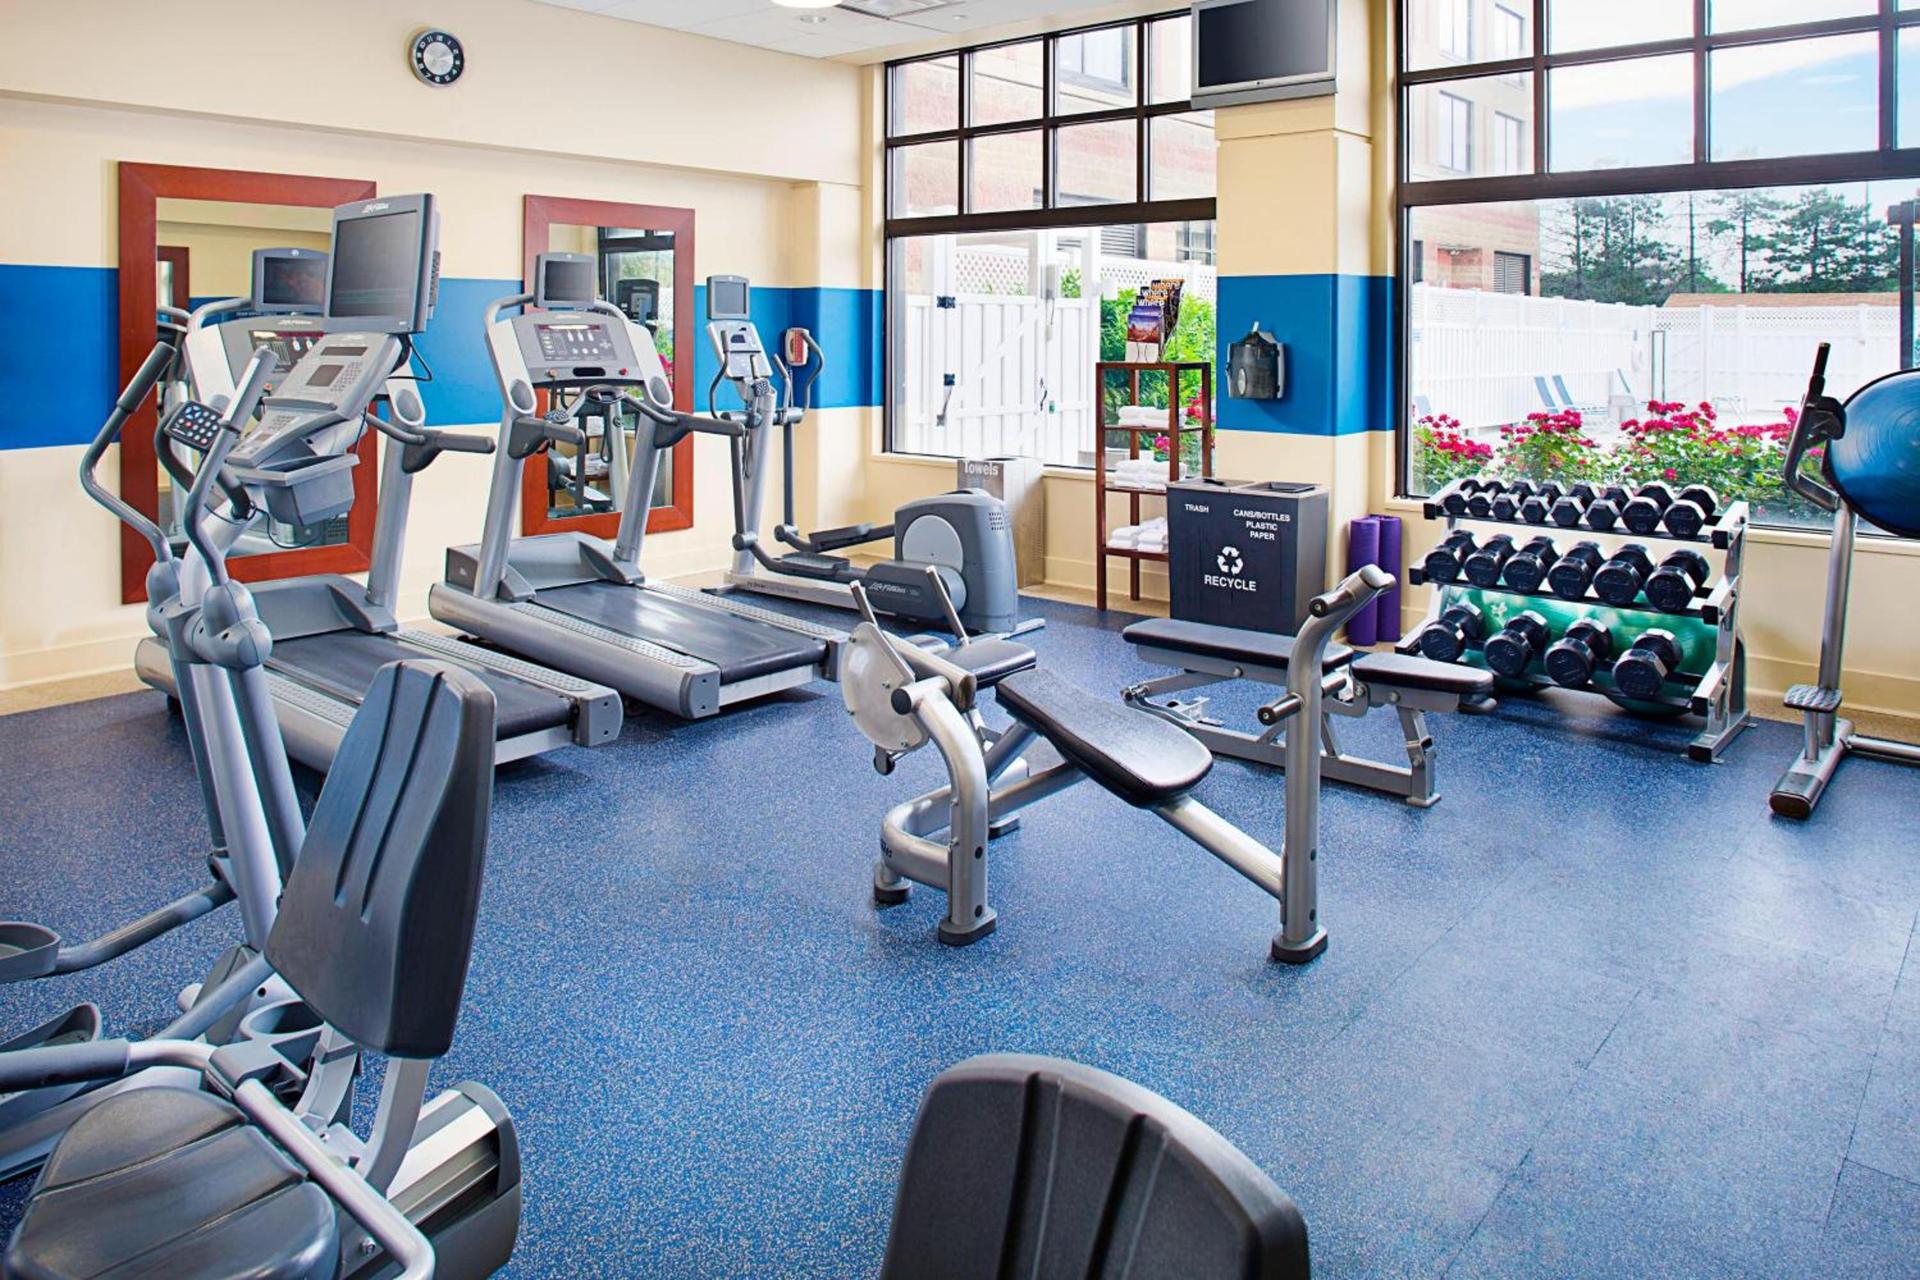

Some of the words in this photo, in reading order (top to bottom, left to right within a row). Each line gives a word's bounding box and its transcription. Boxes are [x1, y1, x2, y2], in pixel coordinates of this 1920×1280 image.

[963, 460, 998, 476] Towels
[1185, 503, 1209, 512] TRASH
[1233, 509, 1291, 522] CANS/BOTTLES
[1246, 520, 1277, 531] PLASTIC
[1250, 530, 1275, 541] PAPER
[1204, 574, 1257, 592] RECYCLE
